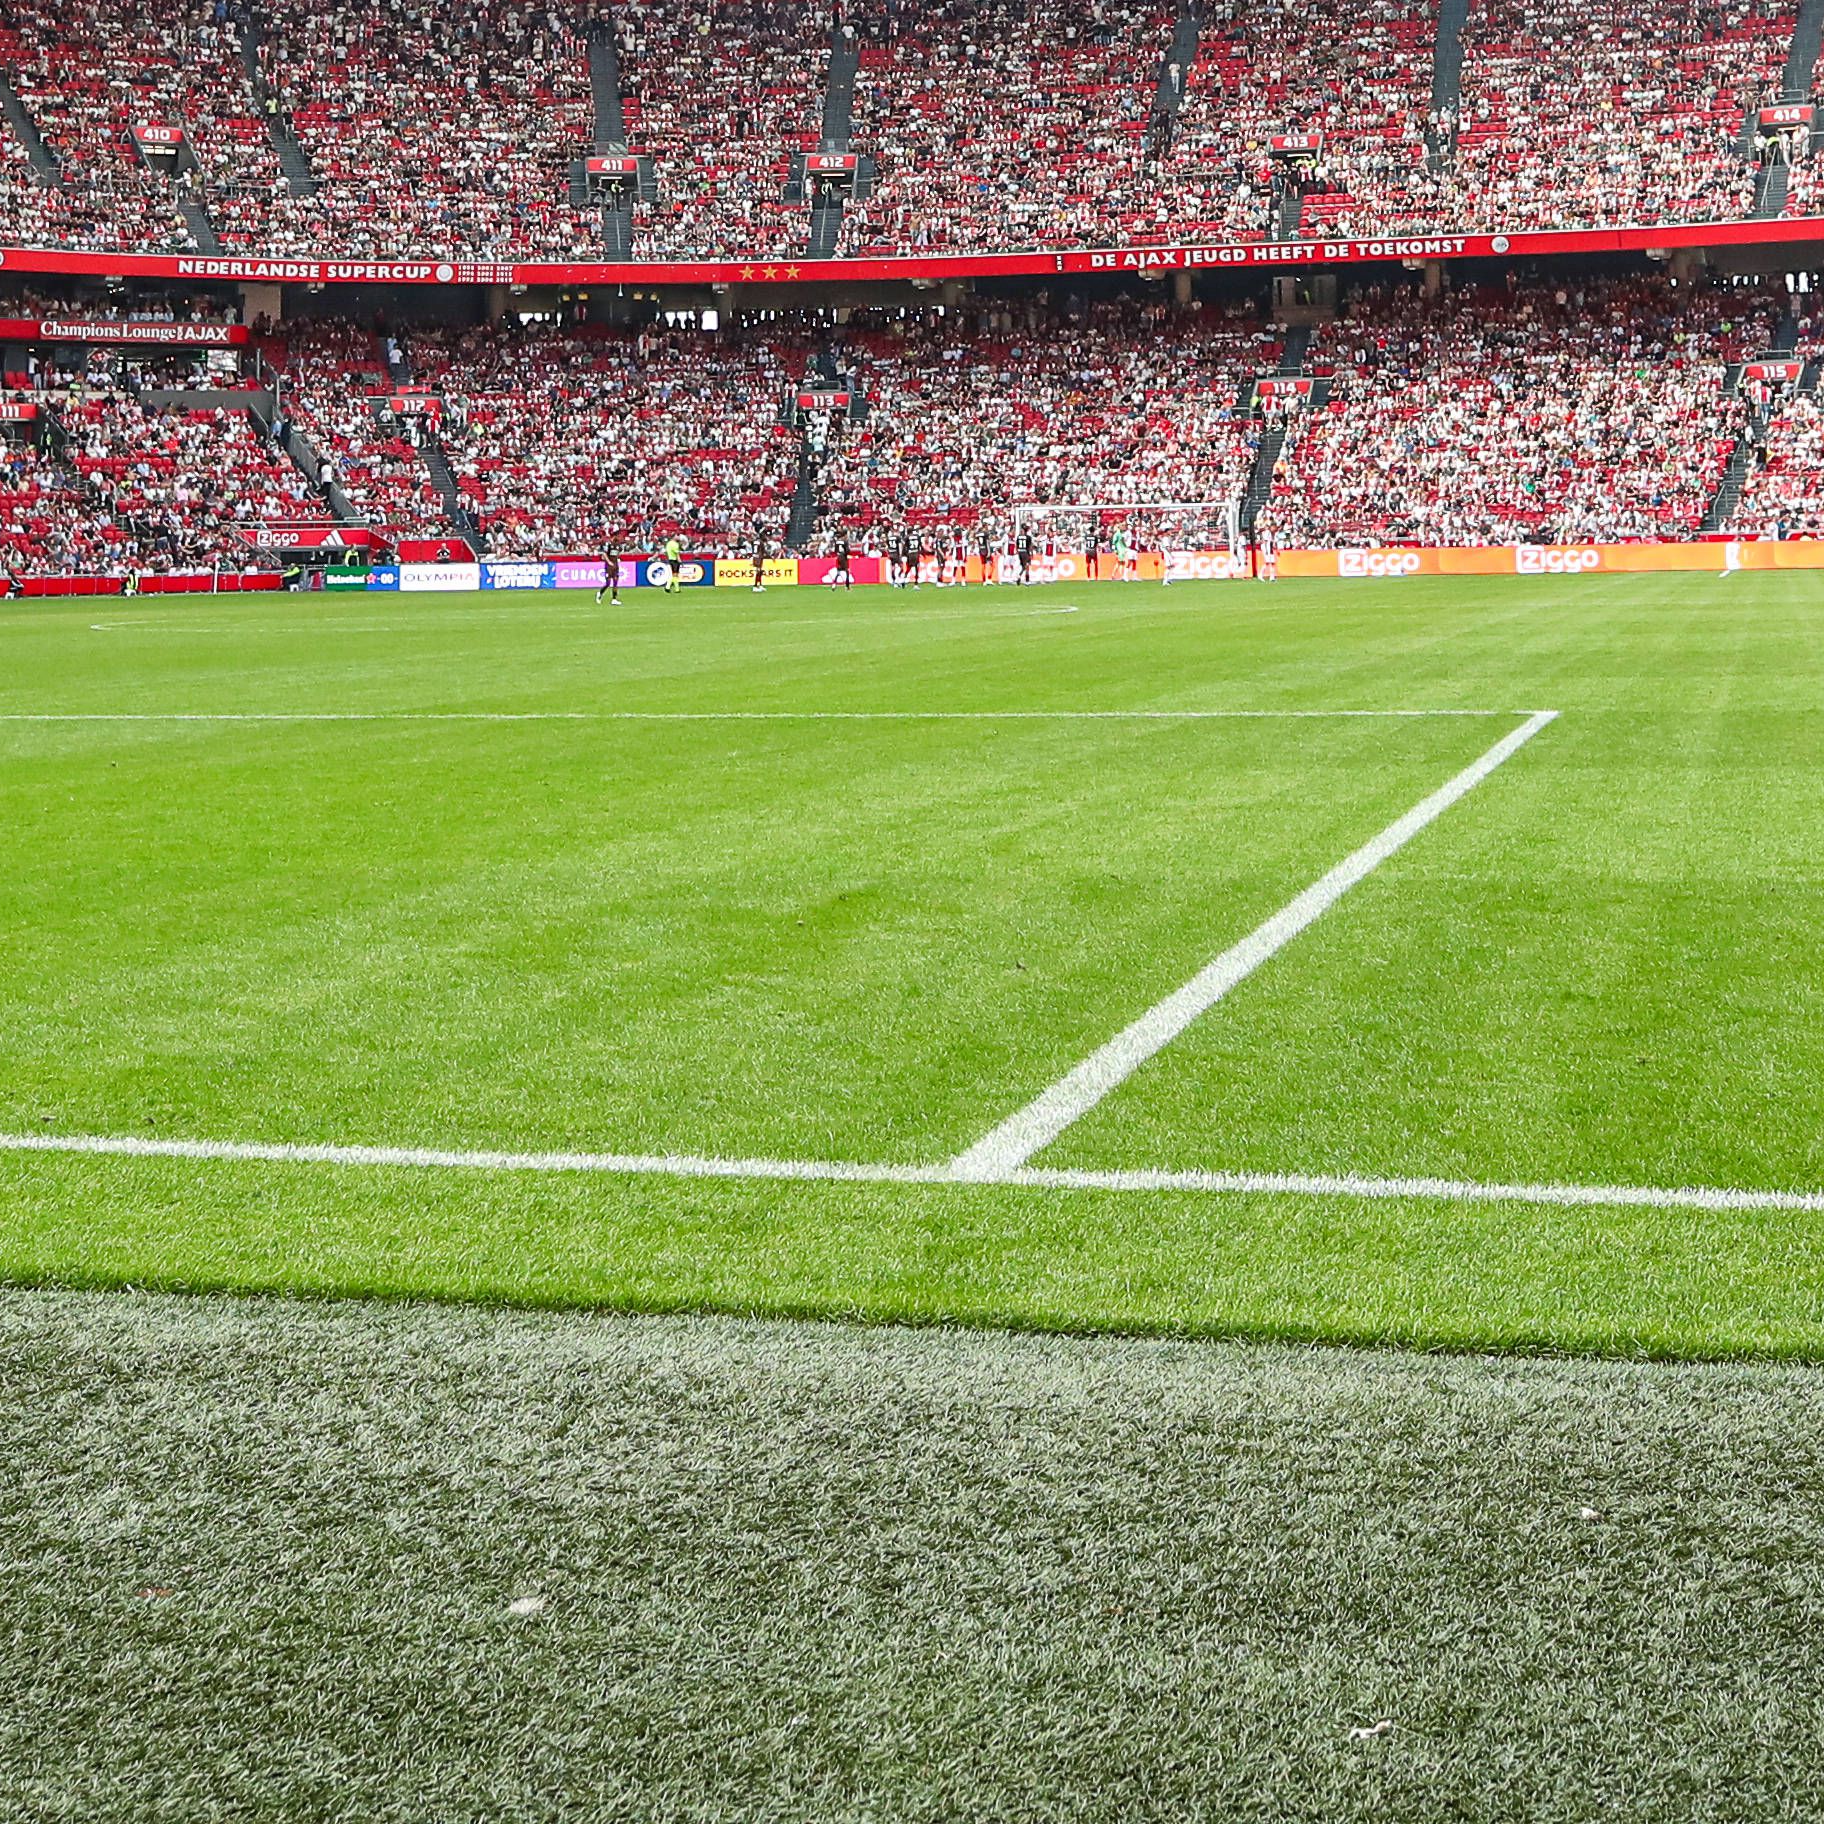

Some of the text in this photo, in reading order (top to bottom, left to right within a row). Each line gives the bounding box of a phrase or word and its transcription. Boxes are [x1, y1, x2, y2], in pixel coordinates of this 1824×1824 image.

[1773, 108, 1801, 121] 414
[143, 129, 170, 141] 410
[1282, 136, 1308, 147] 413
[601, 159, 623, 171] 411
[819, 156, 844, 167] 412
[1091, 239, 1466, 268] DE AJAX JEUGD HEEFT DE TOEKOMST
[178, 260, 432, 279] NEDERLANDSE SUPERCUP
[40, 321, 121, 338] Champions
[122, 323, 177, 341] Lounge
[184, 326, 228, 341] AJAX
[1761, 365, 1787, 377] 115
[1273, 381, 1296, 393] 114
[403, 399, 425, 411] 112
[812, 394, 835, 406] 113
[1, 405, 20, 418] 111
[487, 564, 549, 577] VRIENDEN
[720, 568, 793, 579] ROCKSARS IT
[404, 572, 475, 582] OLYMPIA
